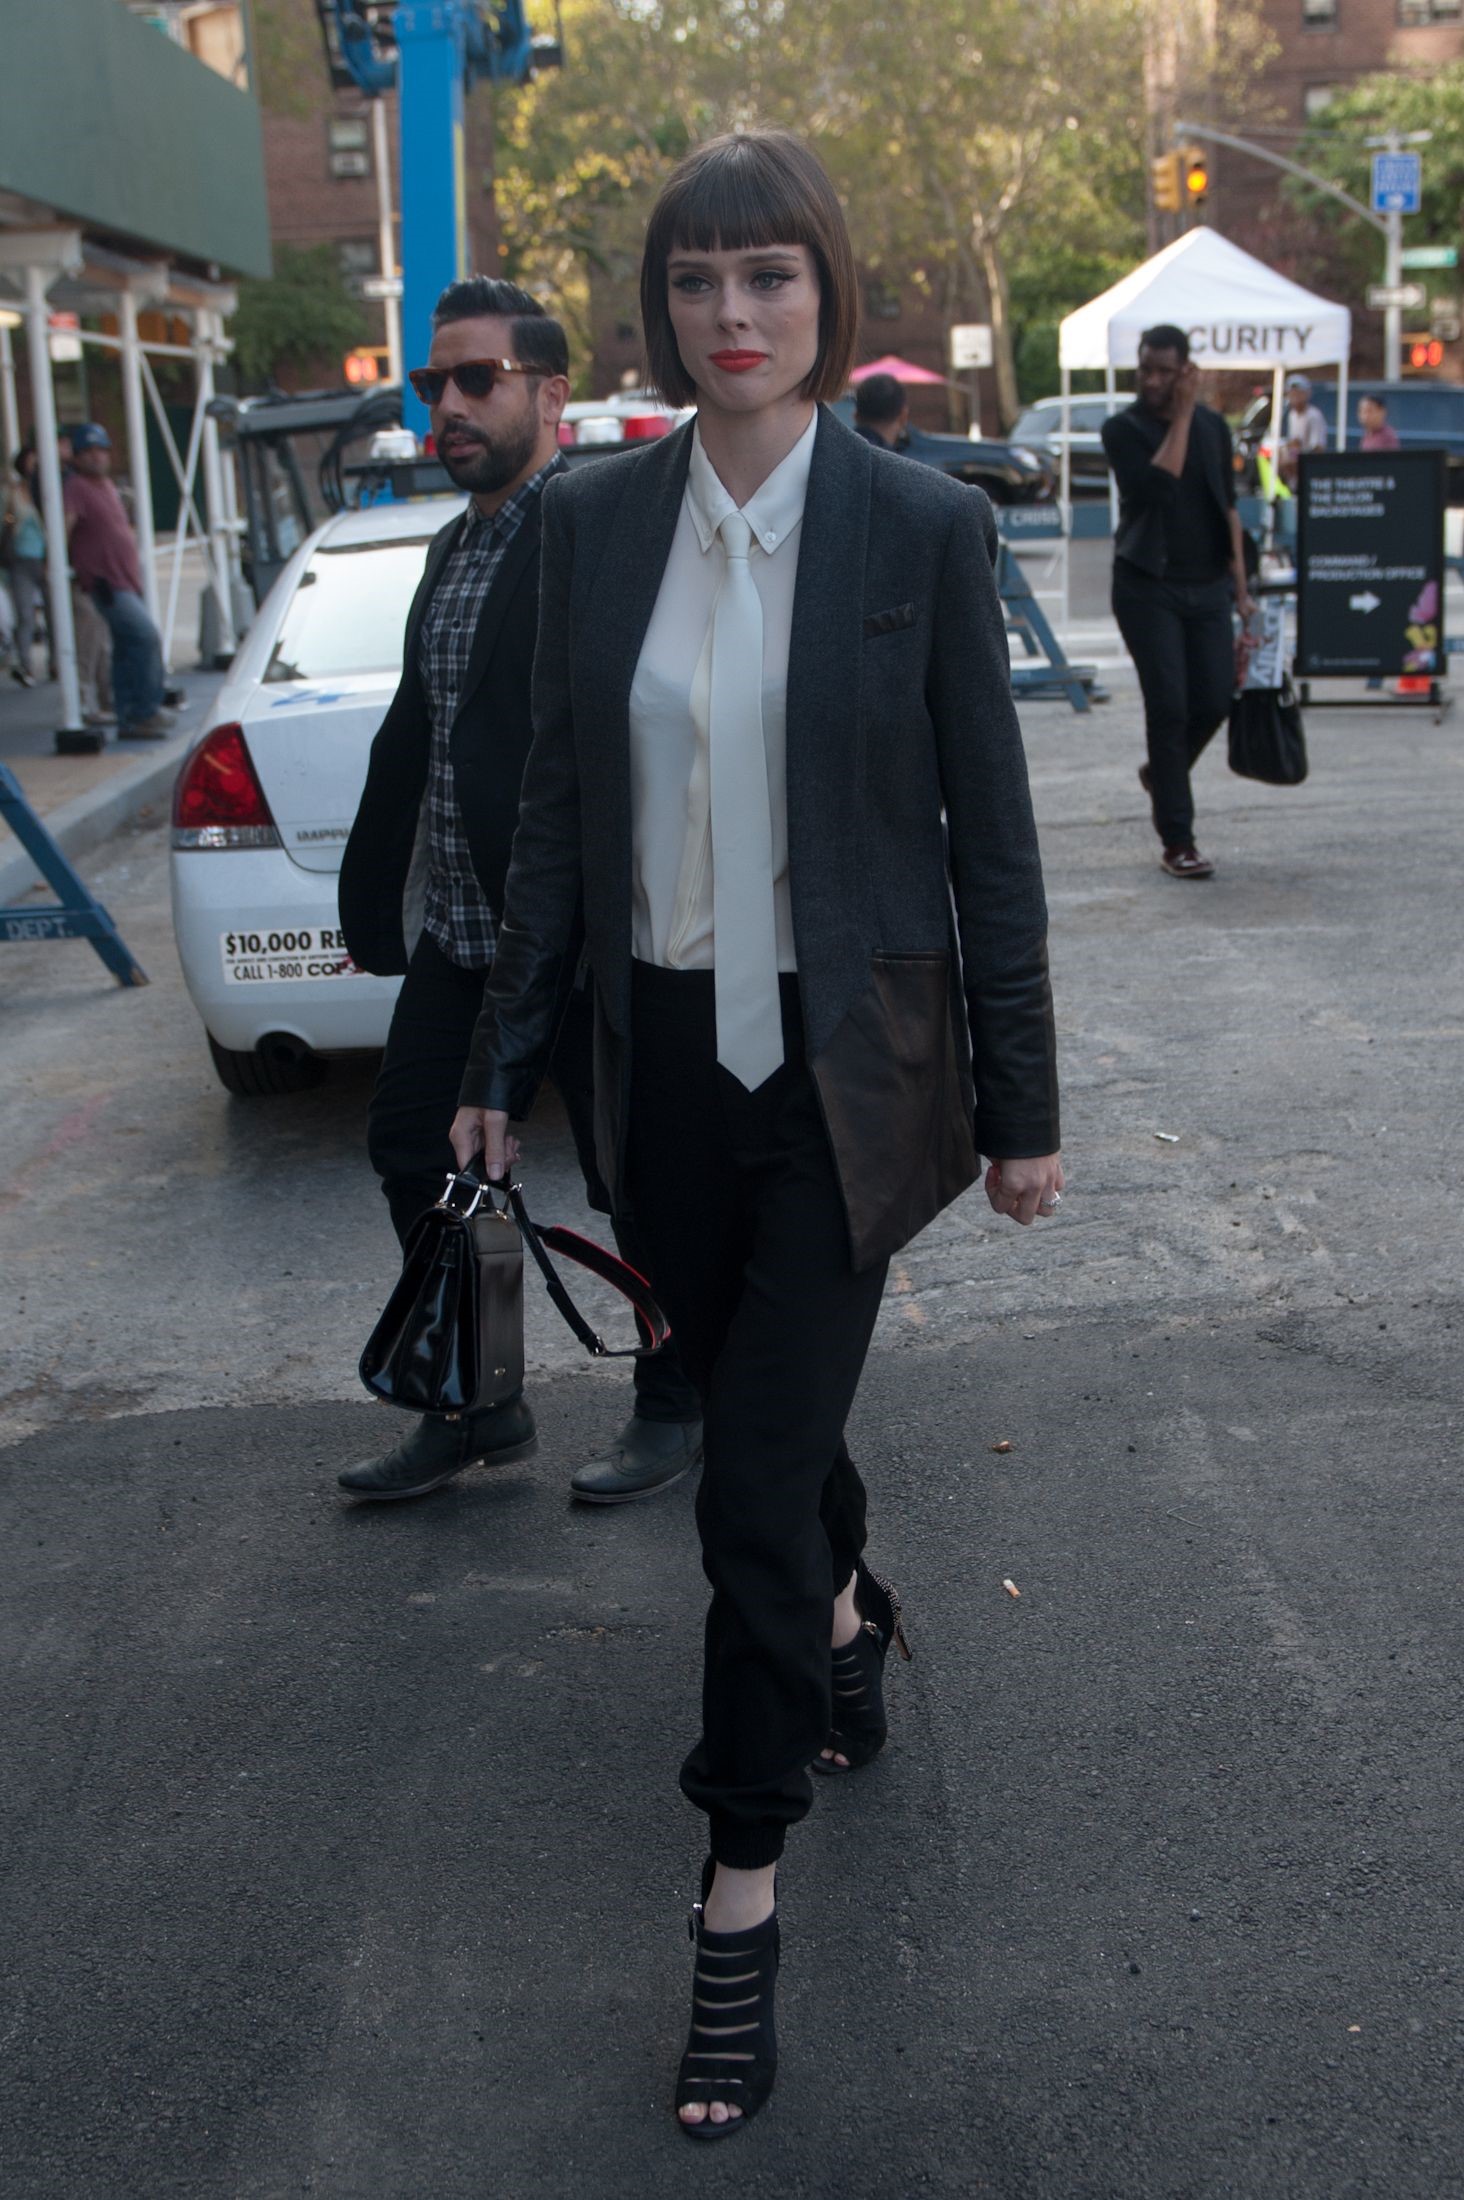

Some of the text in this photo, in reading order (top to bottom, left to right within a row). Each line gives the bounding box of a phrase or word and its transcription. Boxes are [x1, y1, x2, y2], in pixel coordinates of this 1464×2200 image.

[1310, 477, 1332, 491] THE
[1310, 491, 1332, 504] THE
[1308, 566, 1426, 581] PRODUCTION OFFICE
[5, 916, 75, 940] DEPT.
[226, 931, 312, 956] $10,000
[233, 963, 263, 981] CALL
[267, 963, 303, 979] 1-800
